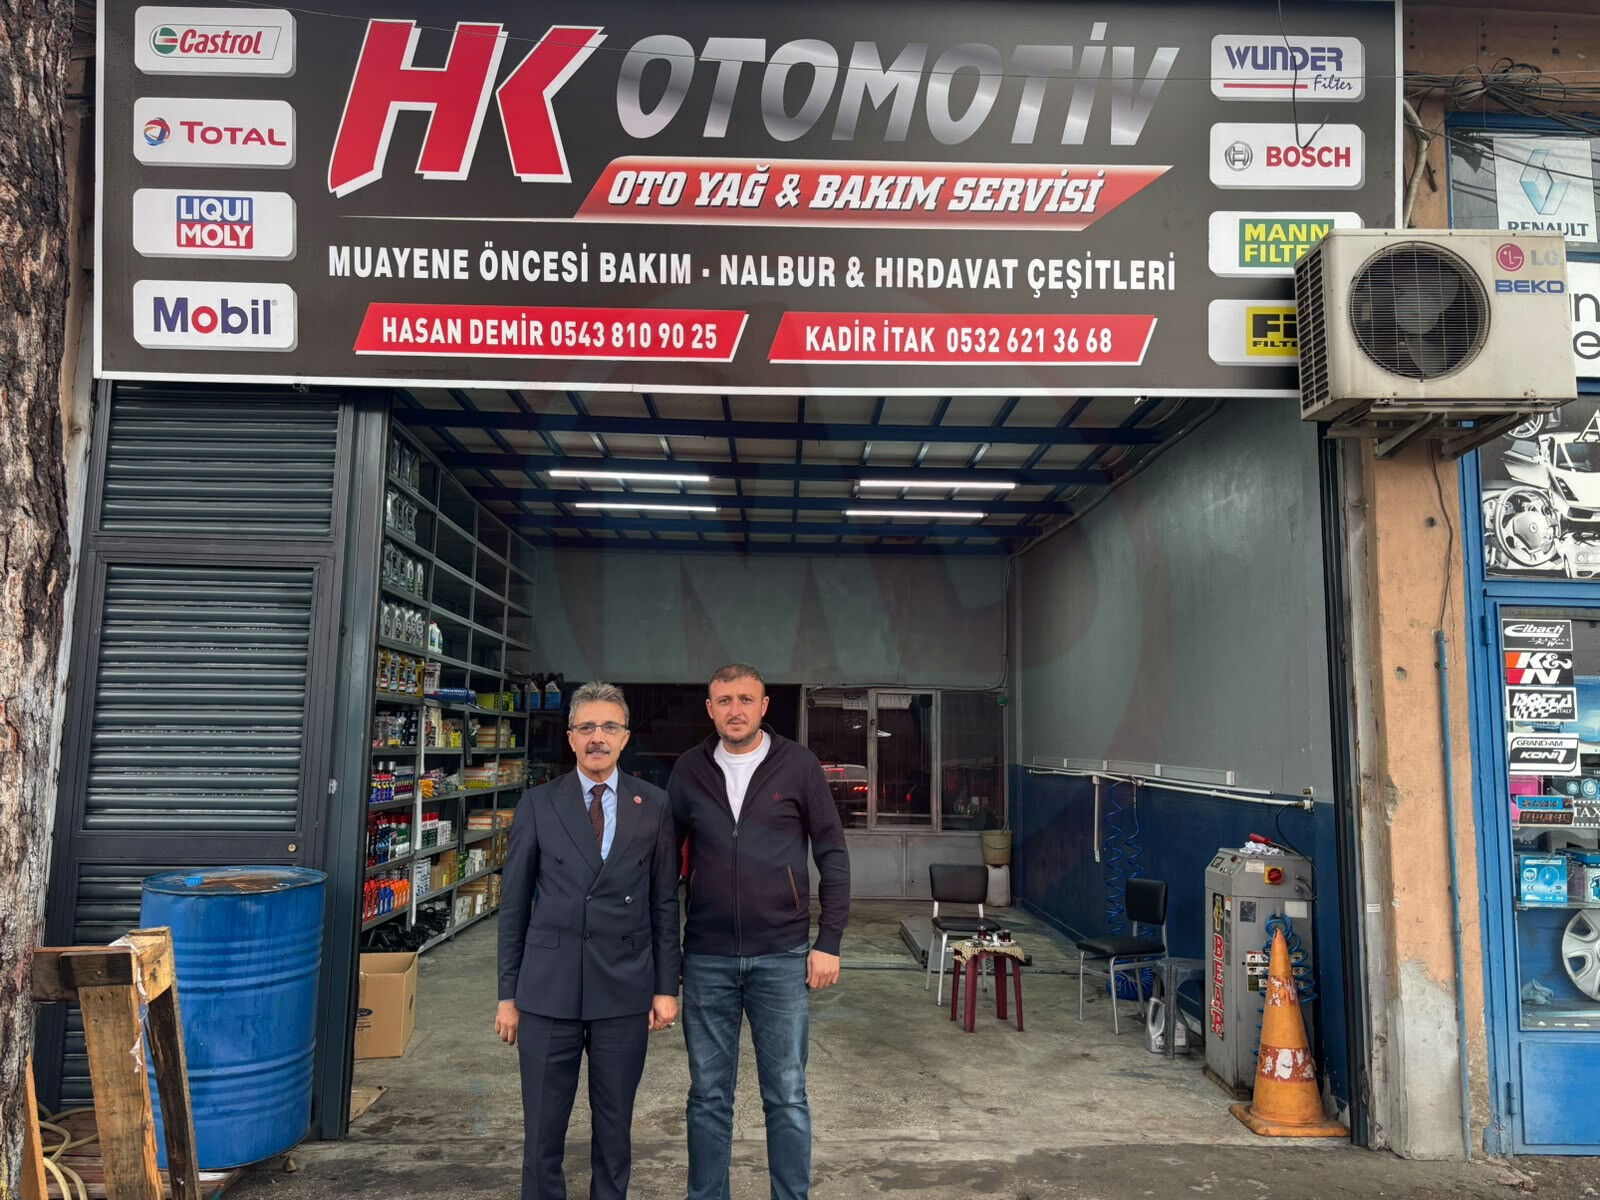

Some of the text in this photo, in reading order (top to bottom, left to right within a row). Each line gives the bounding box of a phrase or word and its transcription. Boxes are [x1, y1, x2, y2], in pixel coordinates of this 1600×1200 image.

[178, 28, 262, 56] Castrol
[1224, 45, 1344, 72] WUNDER
[1313, 74, 1353, 92] Filter
[328, 19, 1180, 198] HK OTOMOTİV
[180, 120, 287, 147] TOTAL
[1265, 146, 1351, 168] BOSCH
[608, 164, 1105, 213] OTO YAĞ & BAKIM SERVİSİ
[180, 197, 250, 222] LIQUI
[180, 223, 252, 247] MOLY
[1244, 223, 1330, 242] MANN
[1244, 244, 1310, 262] FILTE
[1531, 249, 1560, 266] LG
[329, 245, 469, 281] MUAYENE
[480, 241, 589, 283] ÖNCESİ
[600, 252, 692, 285] BAKIM
[720, 254, 836, 288] NALBUR
[846, 256, 865, 289] &
[875, 257, 1018, 289] HIRDAVAT
[1028, 251, 1176, 299] ÇEŞİTLERİ
[1495, 279, 1565, 294] BEKO
[153, 296, 272, 335] Mobil
[382, 312, 718, 350] HASAN DEMİR 0543 810 90 25
[806, 319, 1113, 354] KADİR İTAK 0532 621 36 68
[1252, 340, 1297, 348] FILT
